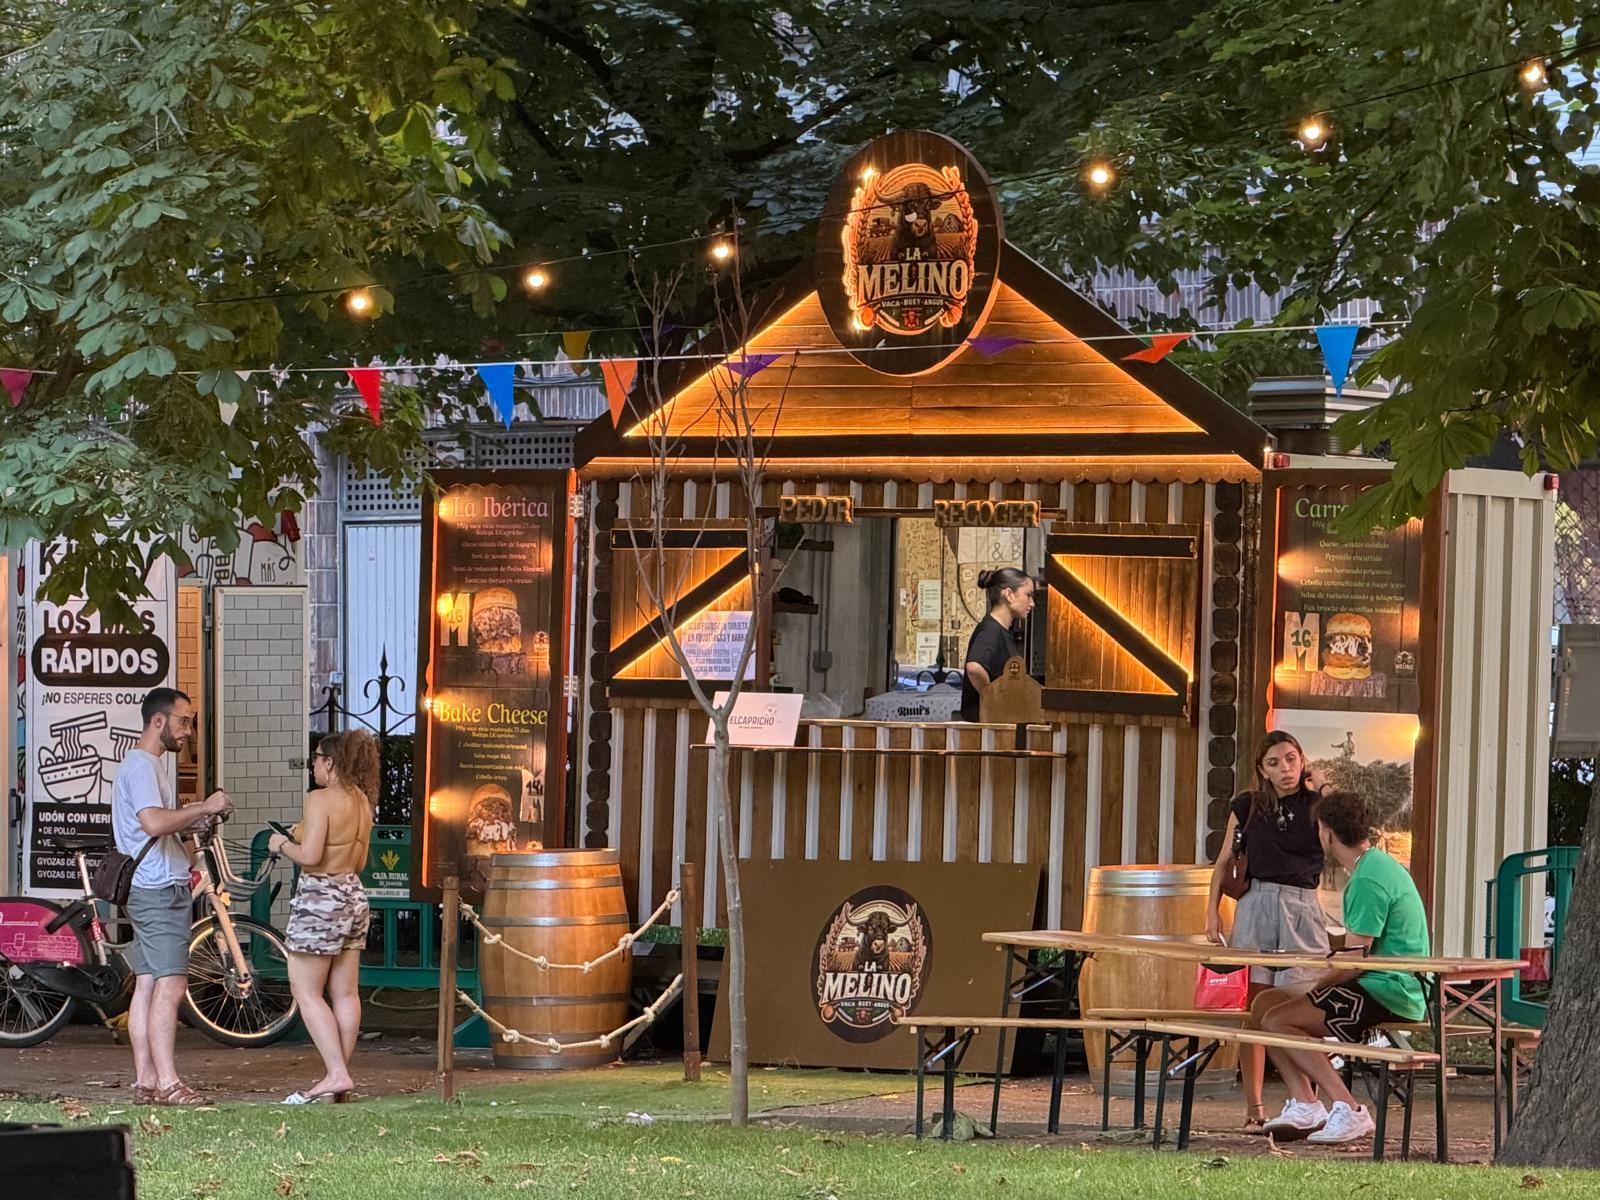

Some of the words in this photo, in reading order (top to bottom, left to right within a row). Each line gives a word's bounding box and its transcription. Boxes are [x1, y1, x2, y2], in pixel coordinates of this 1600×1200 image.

[906, 247, 921, 261] LA
[858, 261, 969, 304] MELINO
[881, 299, 900, 308] VACA
[453, 496, 477, 518] La
[482, 495, 549, 518] Ibérica
[780, 495, 853, 524] PEDIR
[934, 499, 1041, 527] RECOGER
[1295, 497, 1350, 518] Carr
[260, 557, 276, 582] MÁS
[43, 610, 91, 634] LOS
[1290, 629, 1312, 648] 16
[41, 641, 159, 675] RÁPIDOS
[41, 691, 62, 706] ¡NO
[63, 692, 113, 705] ESPERES
[439, 701, 482, 722] Bake
[487, 702, 548, 725] Cheese
[39, 811, 65, 822] UDÓN
[66, 813, 87, 823] CON
[43, 826, 53, 835] DE
[53, 827, 76, 836] POLLO
[37, 857, 65, 866] GYOZAS
[66, 858, 76, 867] DE
[37, 870, 65, 879] GYOZAS
[66, 871, 76, 880] DE
[864, 961, 878, 972] LA
[822, 972, 912, 1004] MELINO
